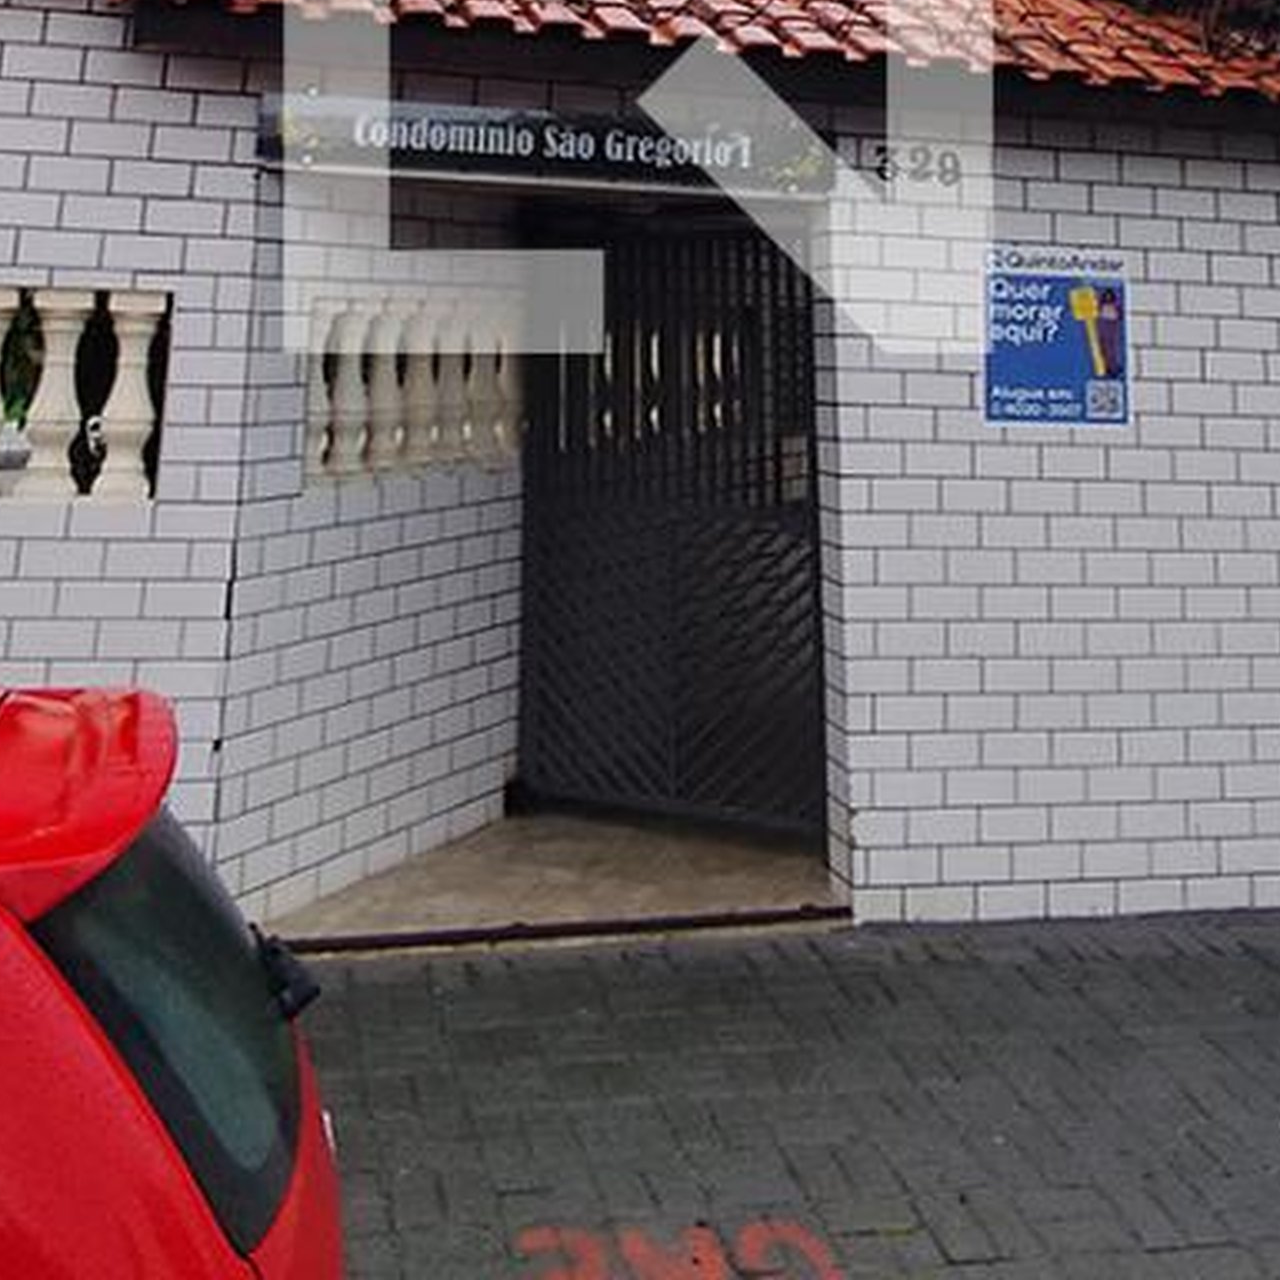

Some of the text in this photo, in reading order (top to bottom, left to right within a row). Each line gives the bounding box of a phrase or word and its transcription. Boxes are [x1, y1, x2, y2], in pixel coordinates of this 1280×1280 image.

[989, 277, 1050, 301] Quer
[990, 304, 1064, 321] morar
[990, 322, 1059, 346] aqui?
